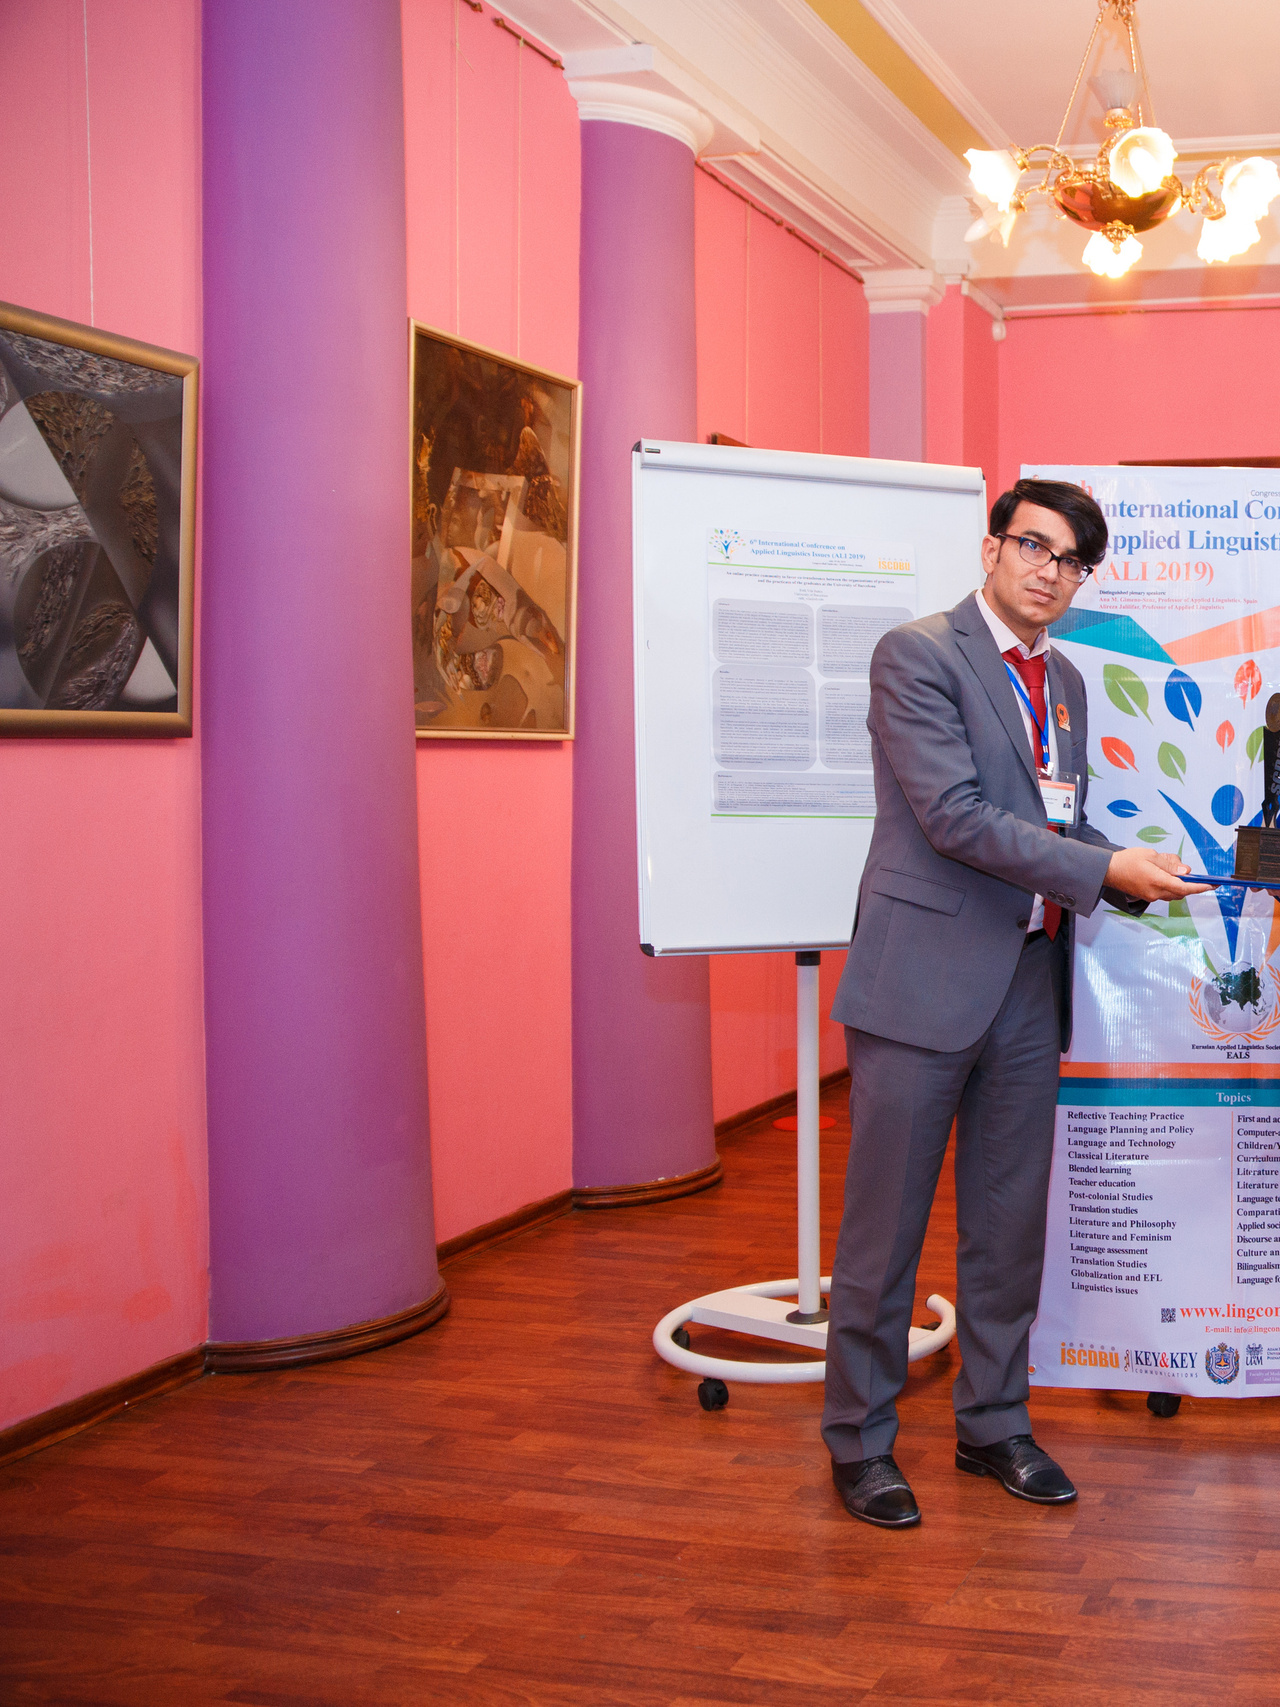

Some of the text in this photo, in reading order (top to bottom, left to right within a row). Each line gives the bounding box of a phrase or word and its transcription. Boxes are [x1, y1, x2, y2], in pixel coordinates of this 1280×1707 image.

[758, 540, 800, 548] International
[801, 542, 836, 550] Conference
[1106, 530, 1181, 556] pplied
[750, 548, 775, 557] Applied
[776, 549, 811, 558] Linguistics
[832, 552, 848, 560] (ALI
[849, 552, 866, 560] 2019)
[1092, 561, 1214, 587] (ALI 2019)
[1226, 1052, 1251, 1060] EALS
[1216, 1092, 1252, 1105] Topics
[1067, 1111, 1185, 1122] Reflective Teaching Practice
[1237, 1114, 1255, 1123] First
[1256, 1115, 1271, 1124] and
[1068, 1125, 1194, 1136] Language Planning and Policy
[1068, 1138, 1176, 1149] Language and Technology
[1068, 1151, 1150, 1160] Classical Literature
[1068, 1164, 1132, 1176] Blended learning
[1237, 1168, 1279, 1176] Literature
[1068, 1178, 1136, 1188] Teacher education
[1068, 1190, 1154, 1201] Post-colonial Studies
[1236, 1194, 1274, 1204] Language
[1069, 1204, 1138, 1214] Translation studies
[1069, 1216, 1177, 1230] Literature and Philosophy
[1236, 1222, 1266, 1231] Applied
[1070, 1230, 1110, 1240] Literature
[1130, 1234, 1172, 1242] Feminism
[1236, 1236, 1272, 1244] Discourse
[1070, 1243, 1148, 1255] Language assessment
[1236, 1249, 1268, 1257] Culture
[1070, 1256, 1148, 1268] Translation Studies
[1070, 1269, 1162, 1282] Globalization and EFL
[1236, 1276, 1273, 1285] Language
[1071, 1282, 1138, 1295] Linguistics issues
[1134, 1350, 1198, 1369] KEY&KEY
[1134, 1368, 1198, 1378] COMMUNICATIONS
